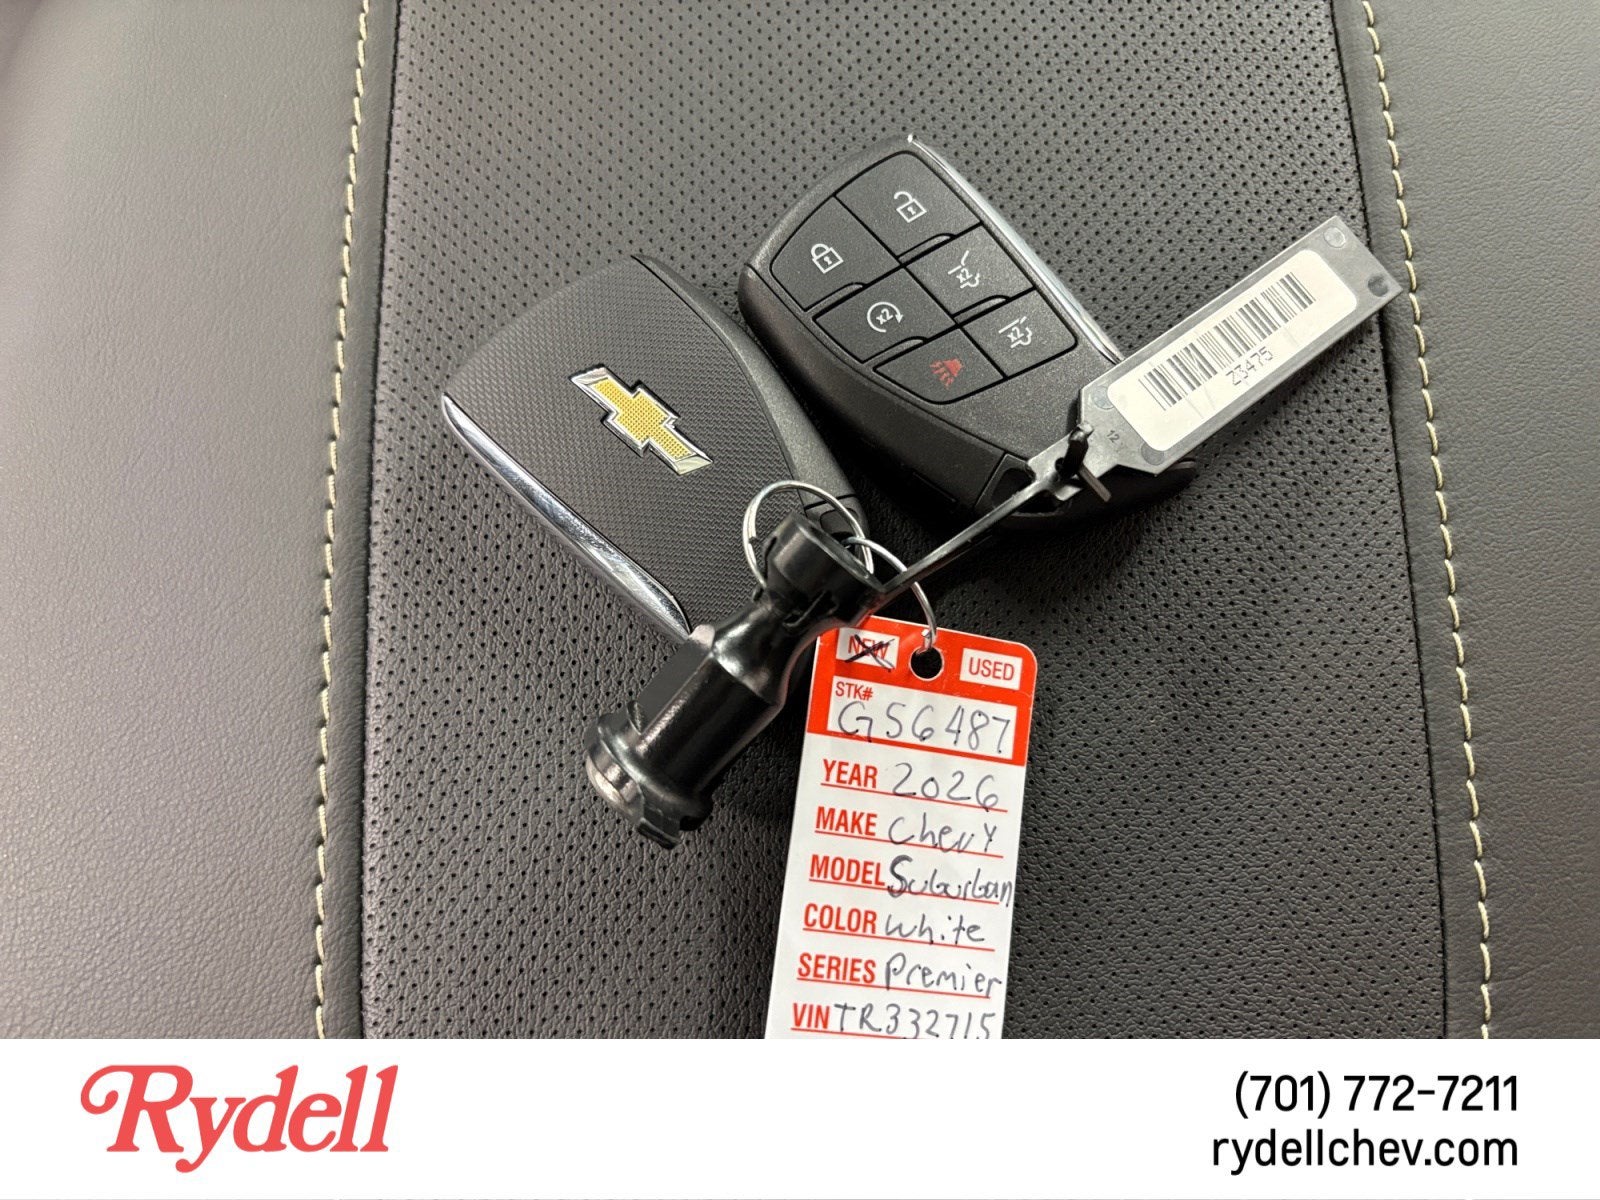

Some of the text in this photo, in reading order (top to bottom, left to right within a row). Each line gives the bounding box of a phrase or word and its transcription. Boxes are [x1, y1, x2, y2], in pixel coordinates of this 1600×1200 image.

[956, 268, 973, 285] x2
[876, 308, 894, 324] x2
[1007, 326, 1025, 343] x2
[968, 657, 1015, 681] USED
[835, 681, 873, 700] STK#
[822, 758, 877, 788] YEAR
[892, 762, 998, 812] 2026
[815, 806, 877, 836] MAKE
[809, 854, 885, 886] MODEL
[887, 855, 1013, 907] Suburban
[803, 902, 877, 934] COLOR
[797, 952, 876, 983] SERIES
[885, 952, 1002, 998] Premier
[792, 1002, 830, 1029] VIN
